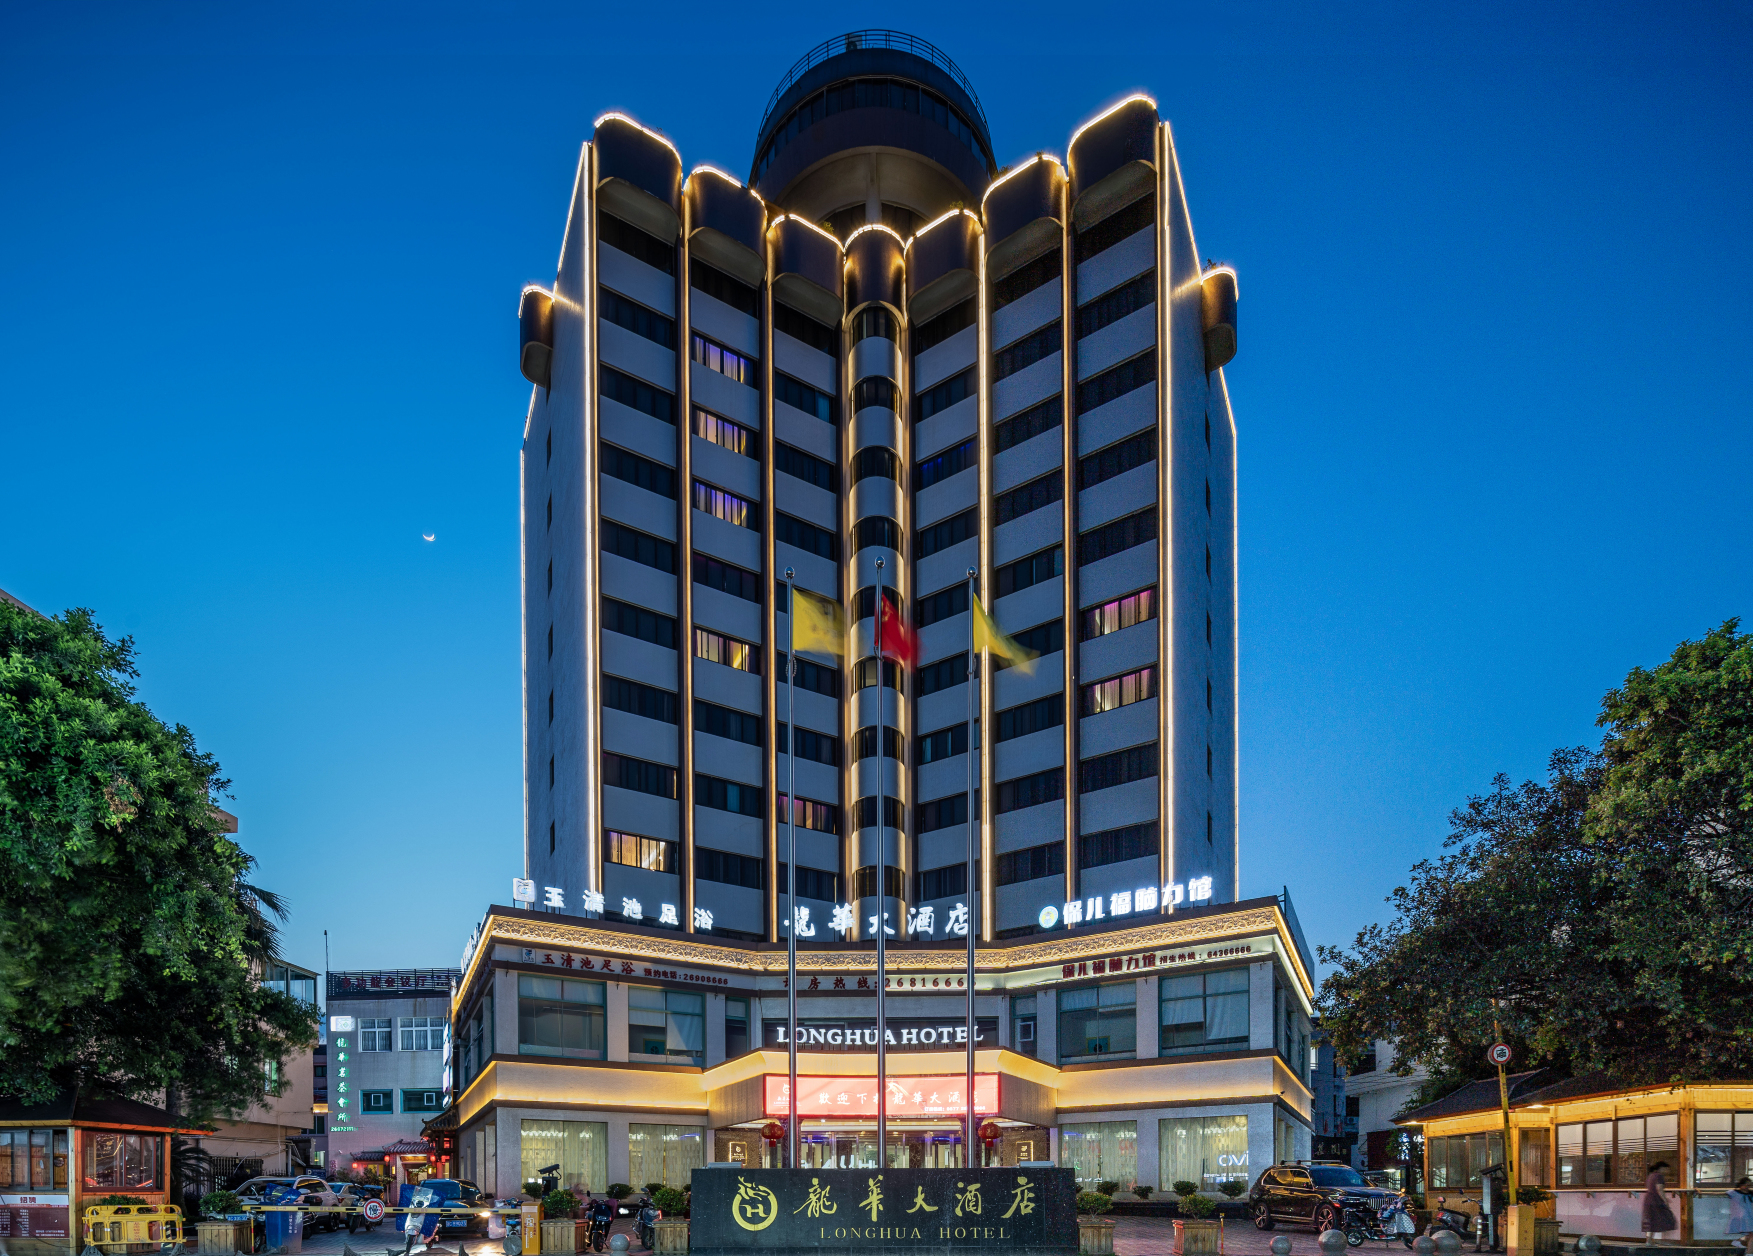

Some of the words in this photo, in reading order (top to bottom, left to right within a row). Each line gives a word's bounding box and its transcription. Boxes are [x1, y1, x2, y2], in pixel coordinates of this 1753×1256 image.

[544, 886, 714, 930] 玉清池足浴
[1062, 875, 1213, 924] 保儿福脑力馆
[541, 952, 636, 975] 玉清池足浴
[1061, 953, 1156, 979] 保儿福脑力馆
[776, 1026, 897, 1045] LONGHUA
[901, 1025, 984, 1045] HOTEL
[820, 1226, 922, 1239] LONGHUA
[939, 1226, 1012, 1239] HOTEL
